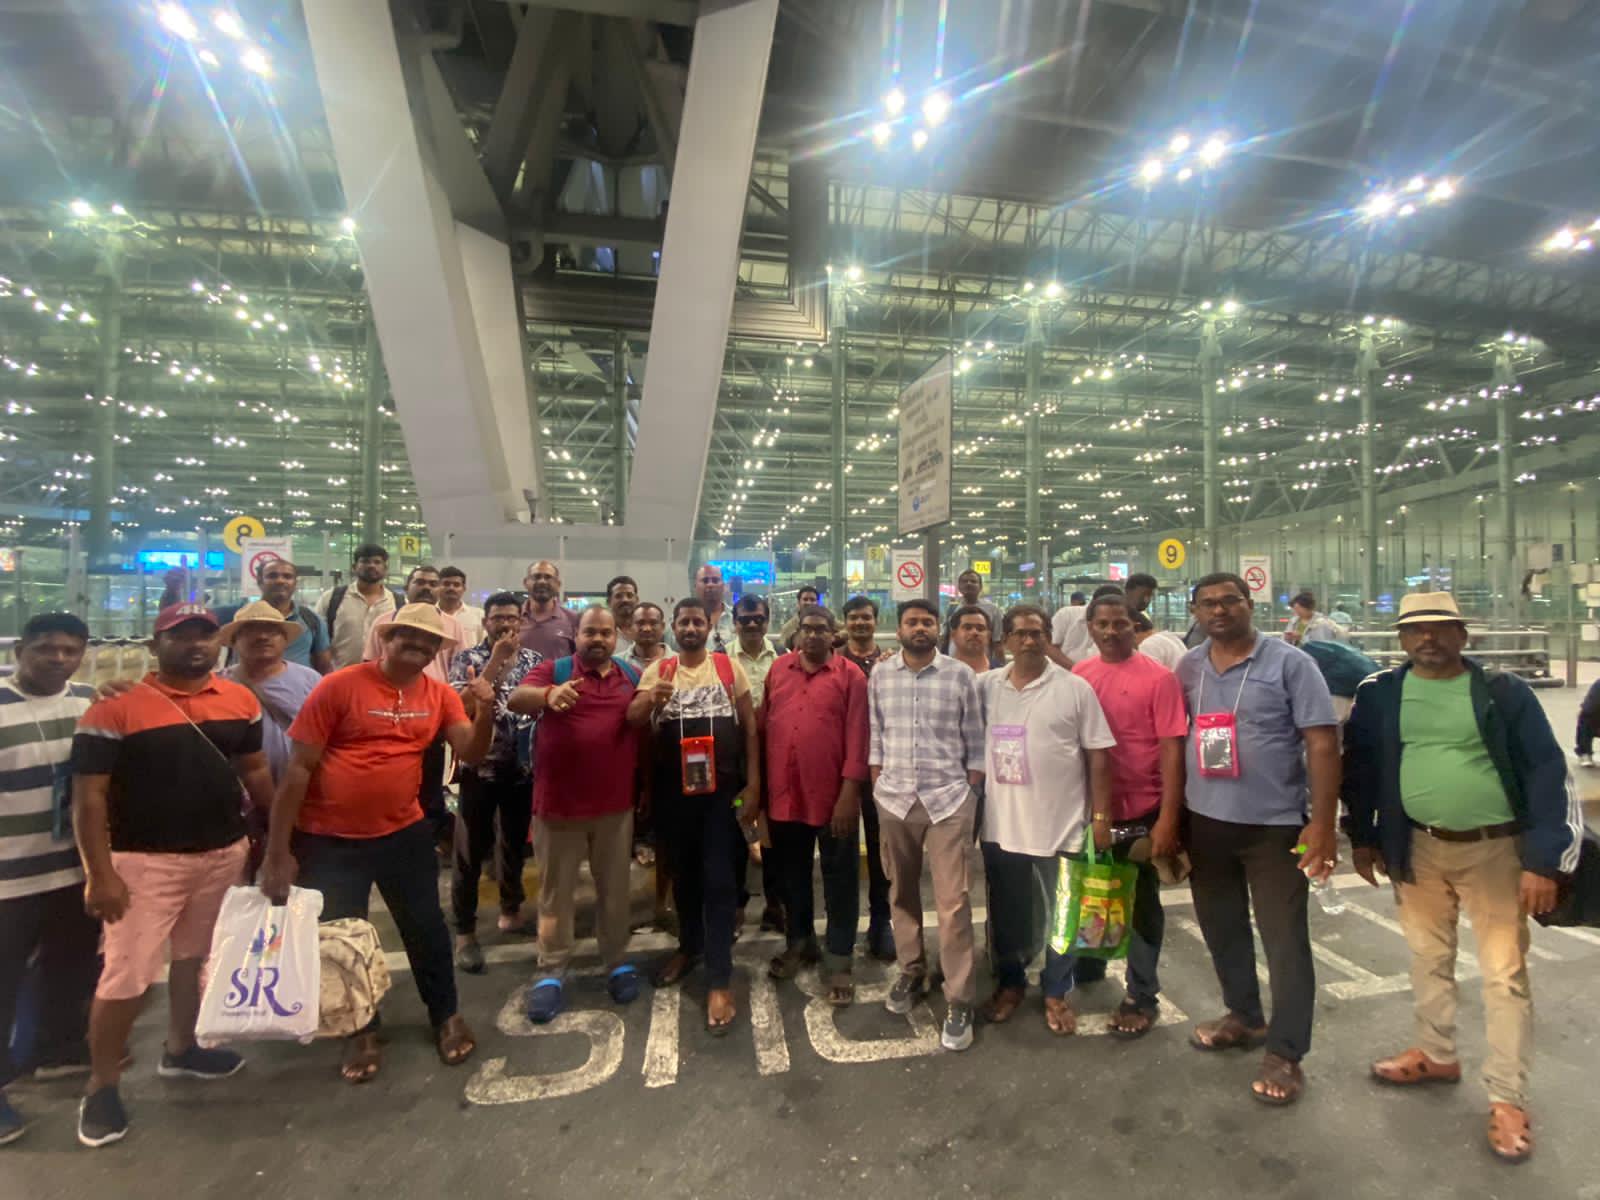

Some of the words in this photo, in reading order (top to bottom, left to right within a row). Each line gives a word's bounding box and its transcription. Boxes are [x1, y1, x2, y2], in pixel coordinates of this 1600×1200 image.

[236, 524, 253, 546] 8
[405, 538, 416, 552] R
[1166, 545, 1177, 564] 9
[224, 967, 303, 1017] SR
